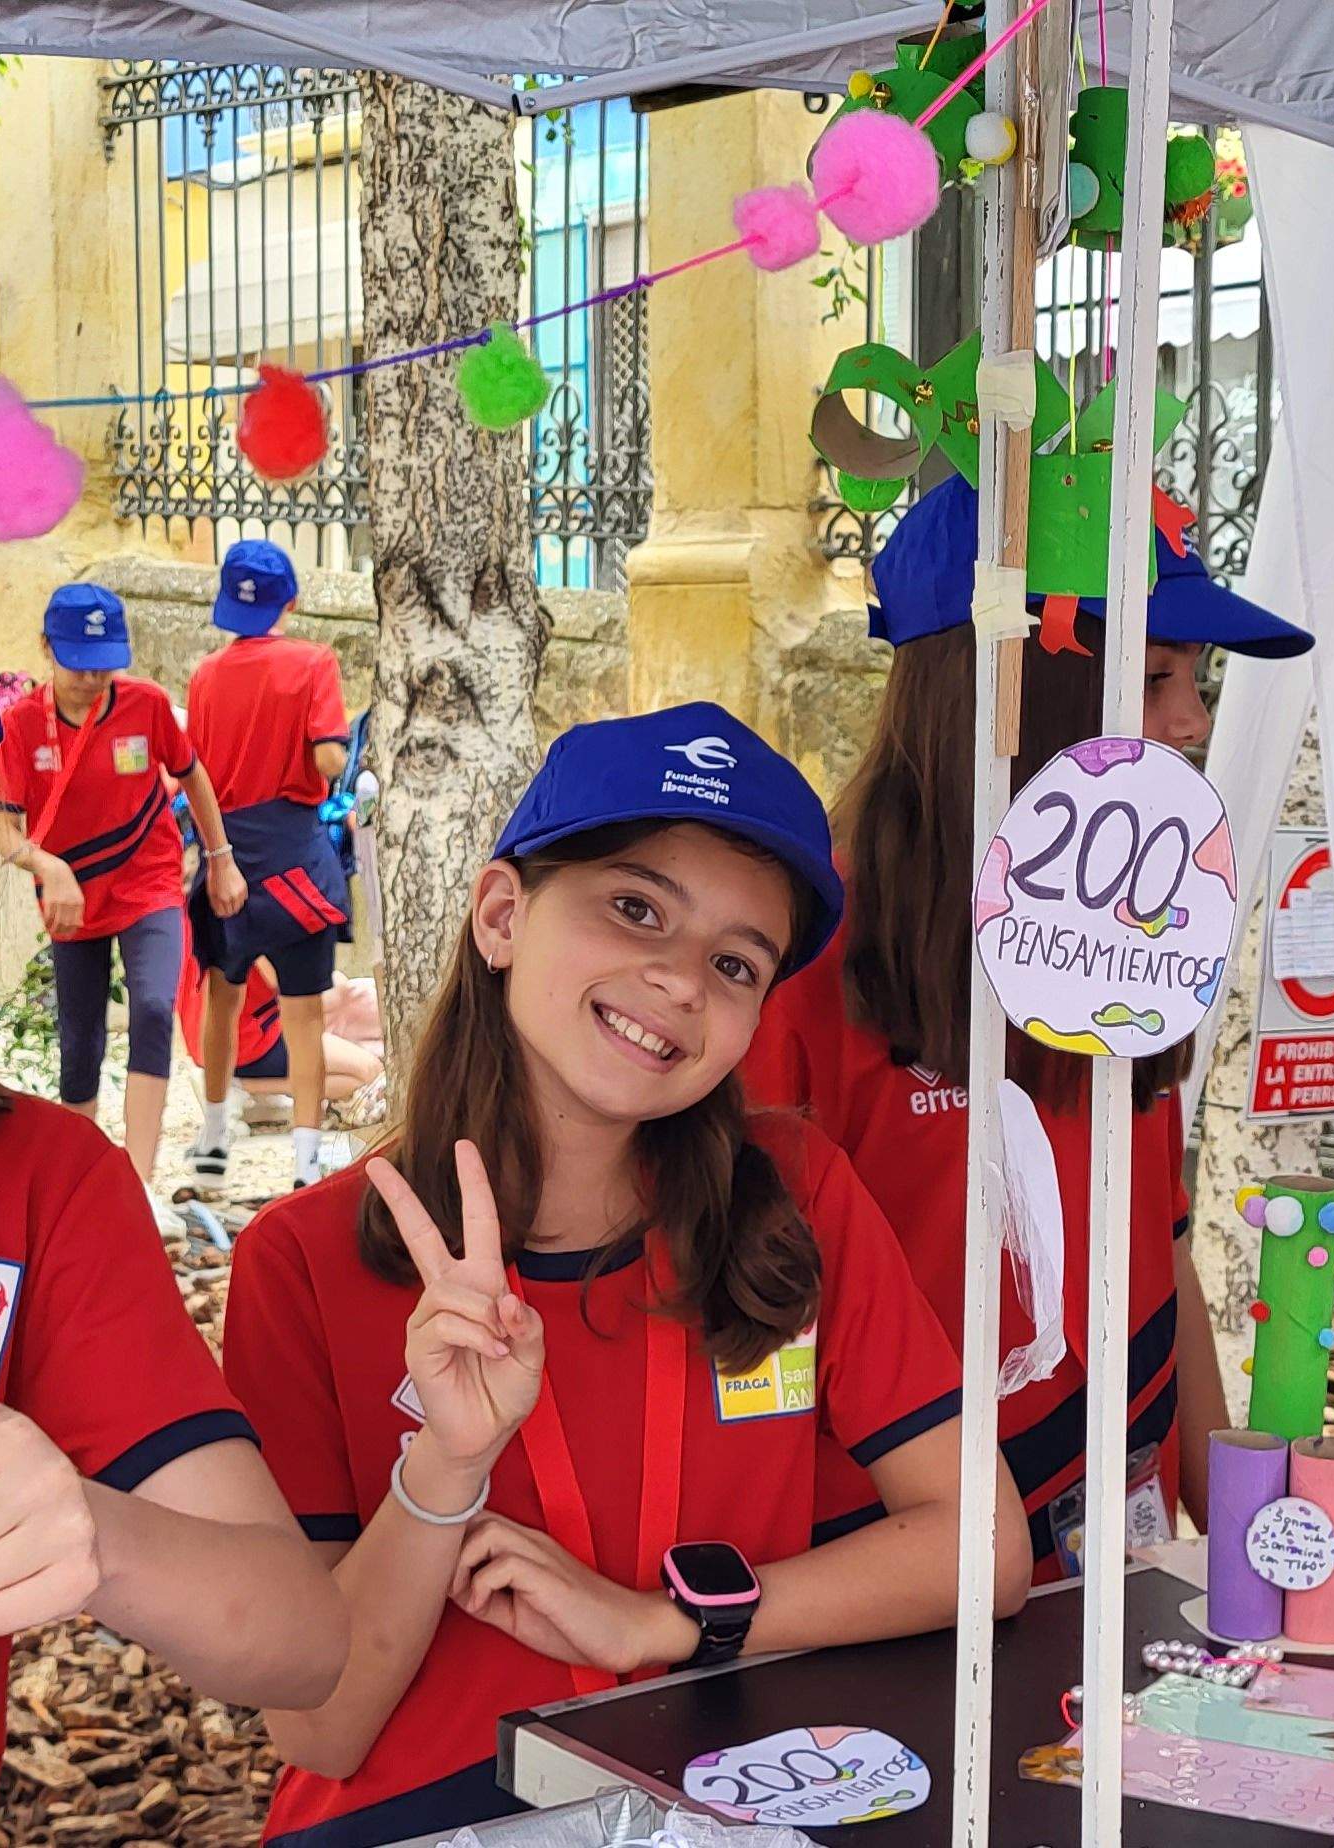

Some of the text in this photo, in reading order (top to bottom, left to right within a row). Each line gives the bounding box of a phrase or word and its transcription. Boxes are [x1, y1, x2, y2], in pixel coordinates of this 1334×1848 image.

[665, 770, 730, 791] Fundación
[1010, 791, 1190, 923] 200
[998, 916, 1214, 989] PENSAMIENTOS
[1264, 1066, 1286, 1085] LA
[910, 1086, 967, 1115] erre
[1270, 1088, 1283, 1108] A
[725, 1378, 771, 1393] FRAGA
[702, 1749, 844, 1804] 200
[762, 1754, 910, 1820] PENSAMIENTOS
